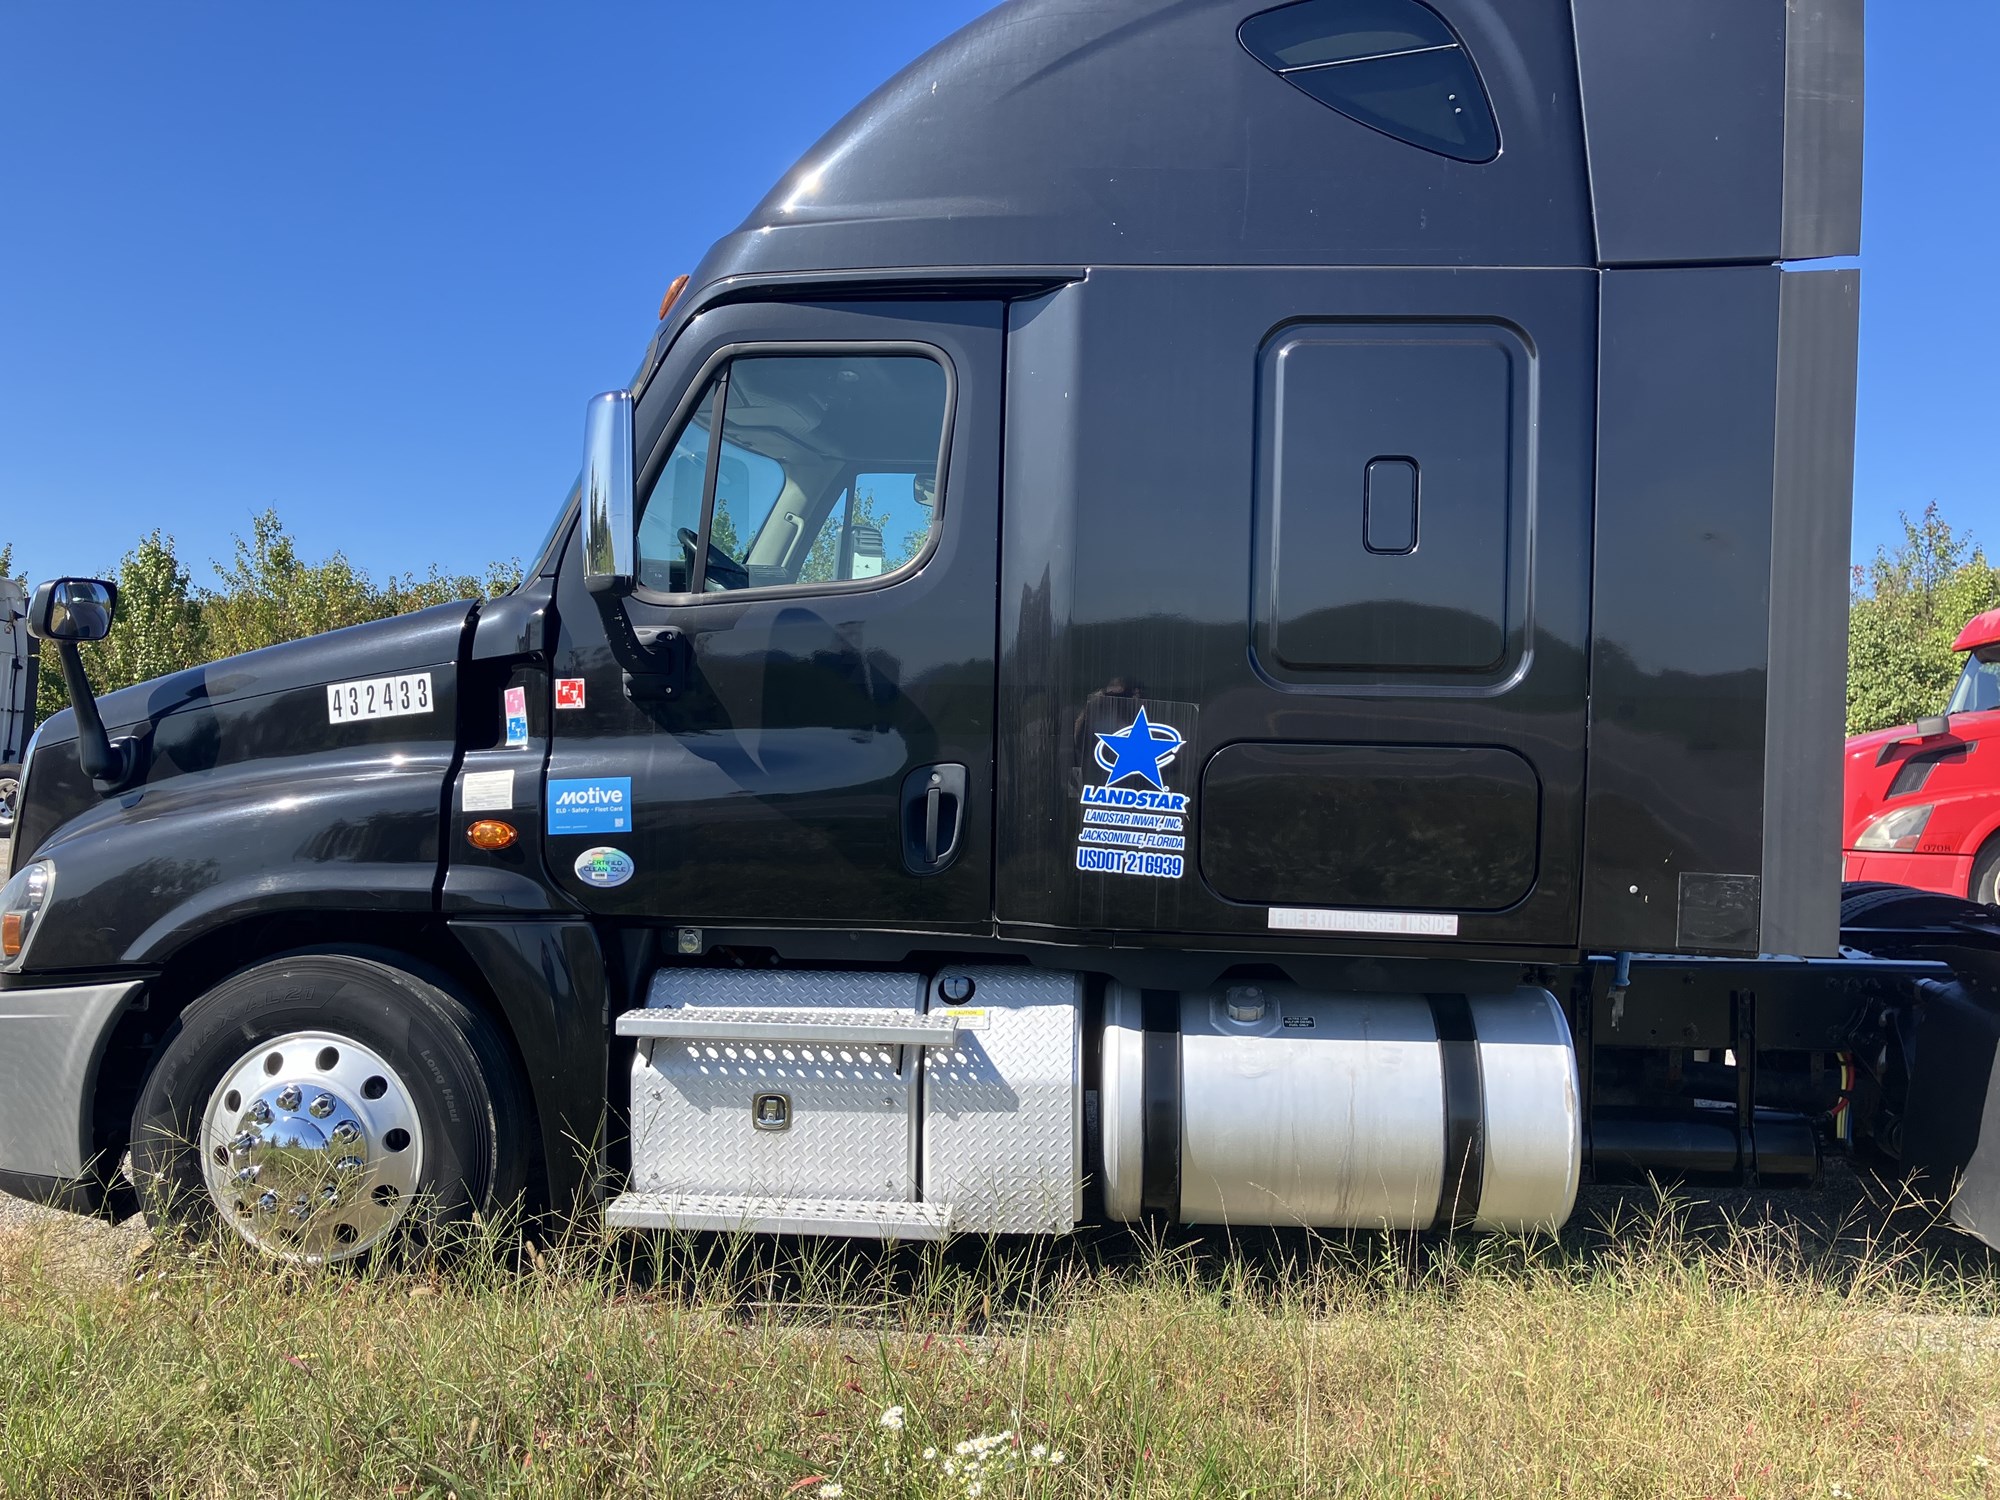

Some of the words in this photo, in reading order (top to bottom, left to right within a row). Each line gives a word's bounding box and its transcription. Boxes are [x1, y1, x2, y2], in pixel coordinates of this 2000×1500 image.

[333, 679, 428, 718] 432433
[556, 786, 623, 805] Motive
[1082, 787, 1184, 811] LANDSTAR
[1085, 811, 1130, 825] LANDSTAR
[1131, 814, 1162, 829] INWAY,
[1164, 817, 1182, 829] INC.
[1080, 830, 1144, 846] JACKSONVILLE,
[1147, 835, 1183, 848] FLORIDA
[1078, 849, 1123, 871] USDOT
[1127, 854, 1182, 876] 216939
[1275, 911, 1304, 927] FIRE
[1309, 912, 1402, 931] EXTINGUISHER
[1406, 915, 1456, 933] INSIDE
[420, 1049, 445, 1084] Long
[442, 1089, 460, 1123] Haul
